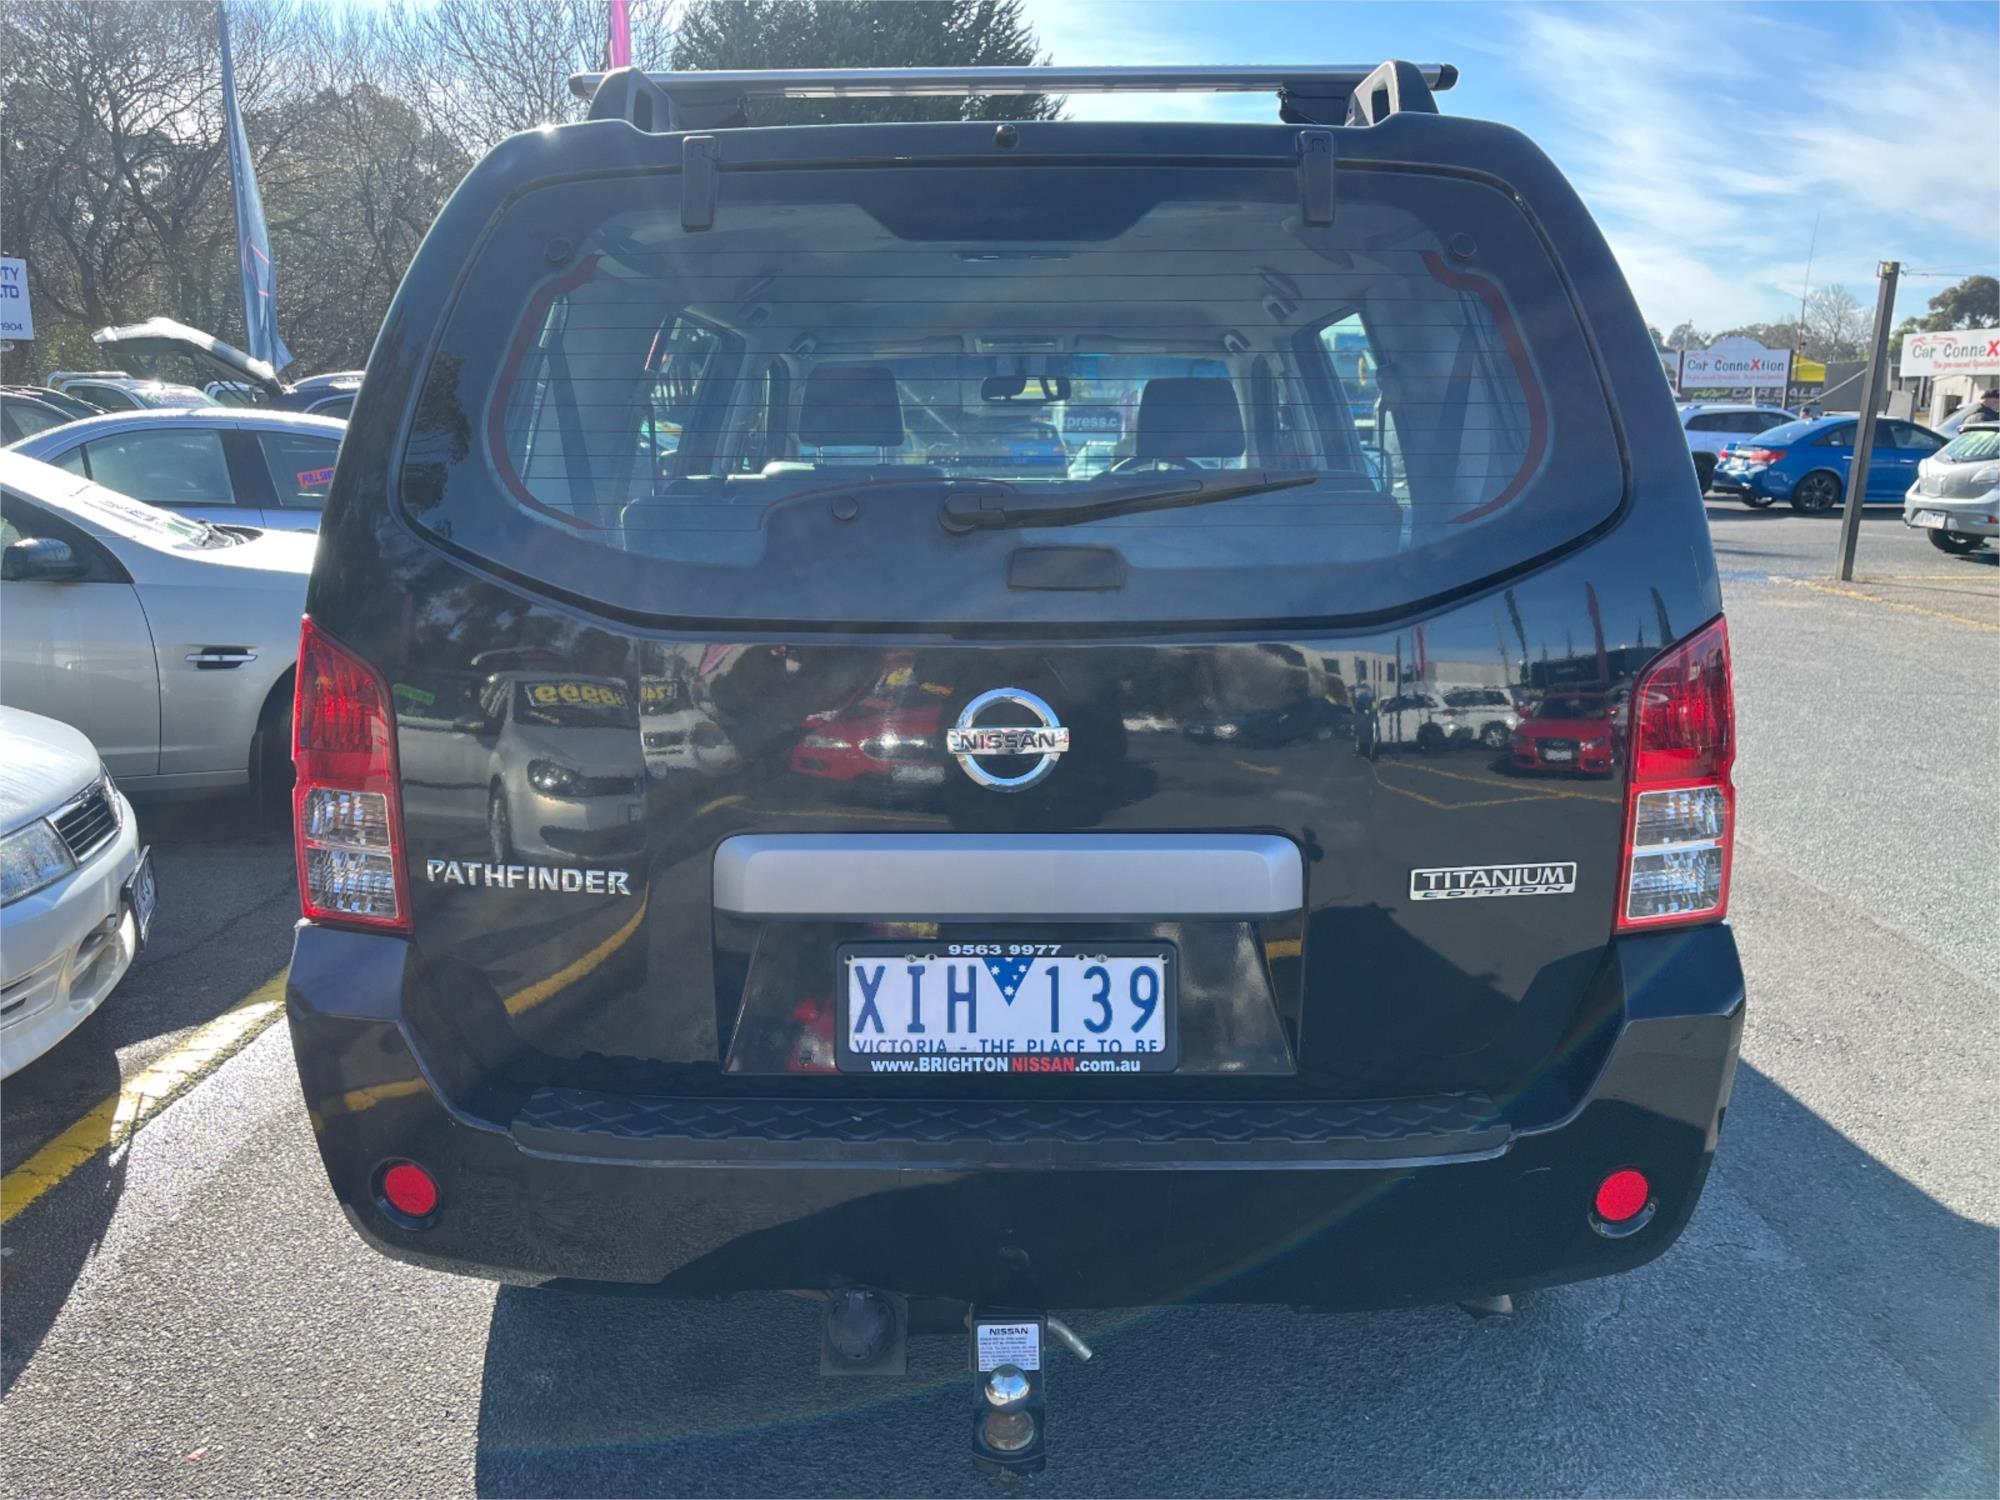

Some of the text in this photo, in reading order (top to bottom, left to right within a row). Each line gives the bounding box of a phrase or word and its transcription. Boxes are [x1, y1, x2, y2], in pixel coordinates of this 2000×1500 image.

[0, 266, 19, 280] TY
[1912, 344, 1937, 359] Car
[1687, 358, 1785, 372] Car ConneXtion
[960, 733, 1055, 750] NISSAN
[426, 859, 632, 896] PATHFINDER
[1422, 867, 1566, 890] TITANIUM
[1421, 885, 1565, 899] EDITION
[948, 944, 1062, 956] 9563 9977
[853, 965, 1160, 1034] XIH 139
[854, 1039, 948, 1054] VICTORIA
[1097, 1039, 1122, 1053] TO
[989, 1327, 1029, 1336] NISSAN
